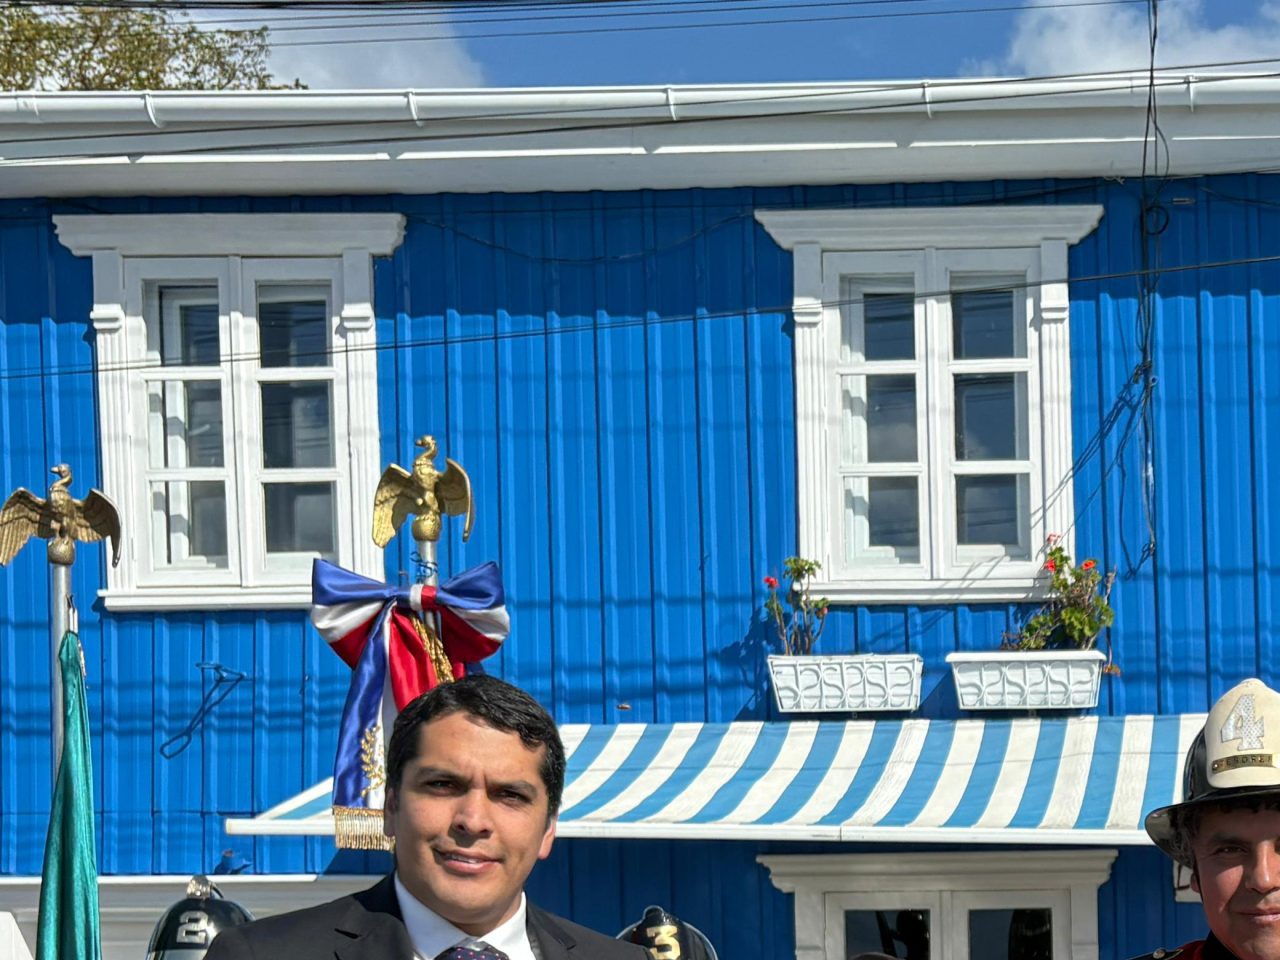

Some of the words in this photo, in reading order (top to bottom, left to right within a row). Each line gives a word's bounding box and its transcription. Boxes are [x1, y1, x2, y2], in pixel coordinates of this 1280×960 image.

[1220, 694, 1265, 751] 4
[176, 910, 209, 944] 2
[646, 925, 681, 960] 3
